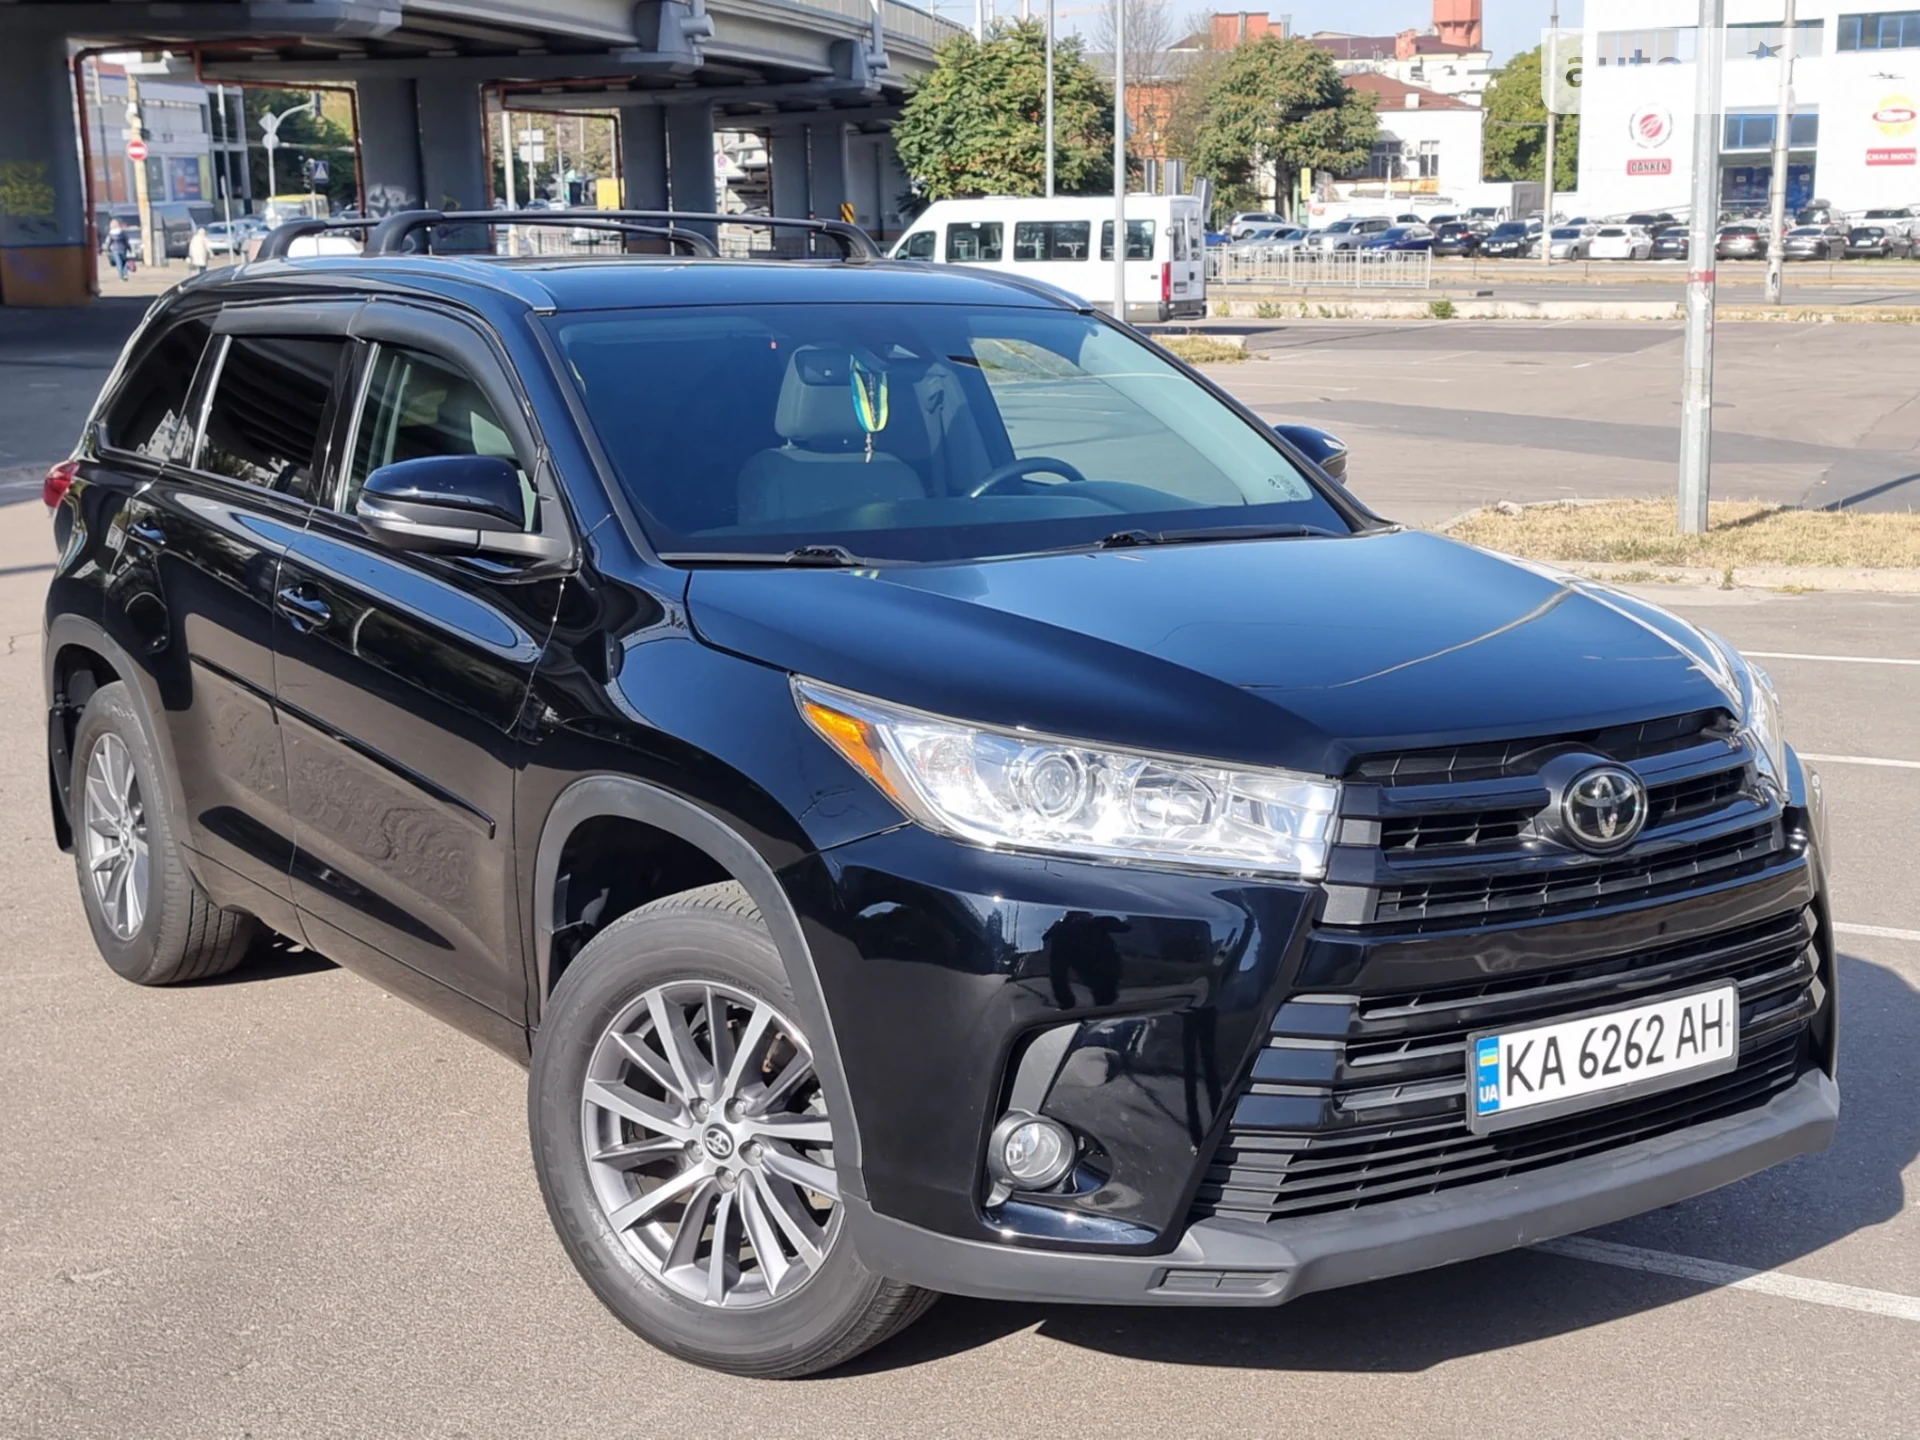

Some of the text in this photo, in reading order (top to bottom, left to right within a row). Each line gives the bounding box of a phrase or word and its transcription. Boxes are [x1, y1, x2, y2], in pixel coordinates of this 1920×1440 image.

[1631, 161, 1667, 172] DANKEN
[1506, 998, 1724, 1097] KA 6262 AH
[1479, 1084, 1499, 1103] UA
